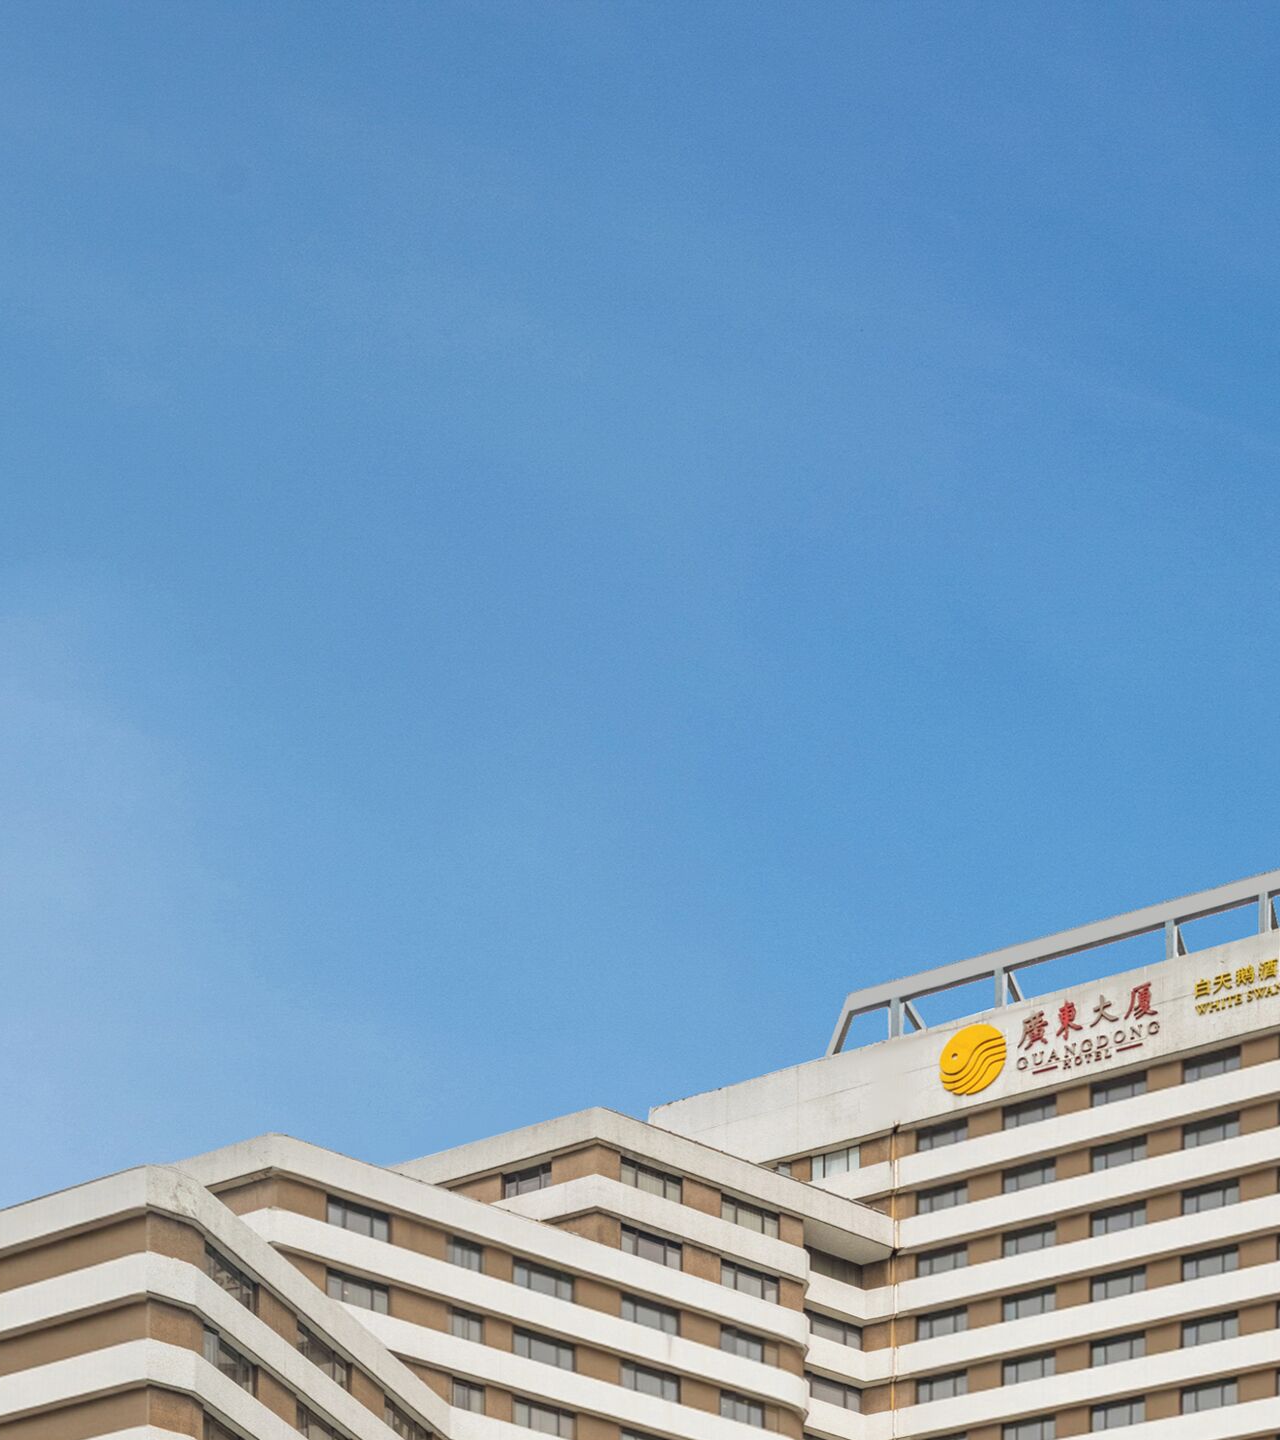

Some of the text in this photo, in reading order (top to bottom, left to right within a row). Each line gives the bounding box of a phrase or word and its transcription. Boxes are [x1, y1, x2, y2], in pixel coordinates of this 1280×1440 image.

[1195, 994, 1243, 1016] WHITE
[1016, 1021, 1160, 1071] GUANGDONG
[1062, 1049, 1112, 1070] HOTEL
